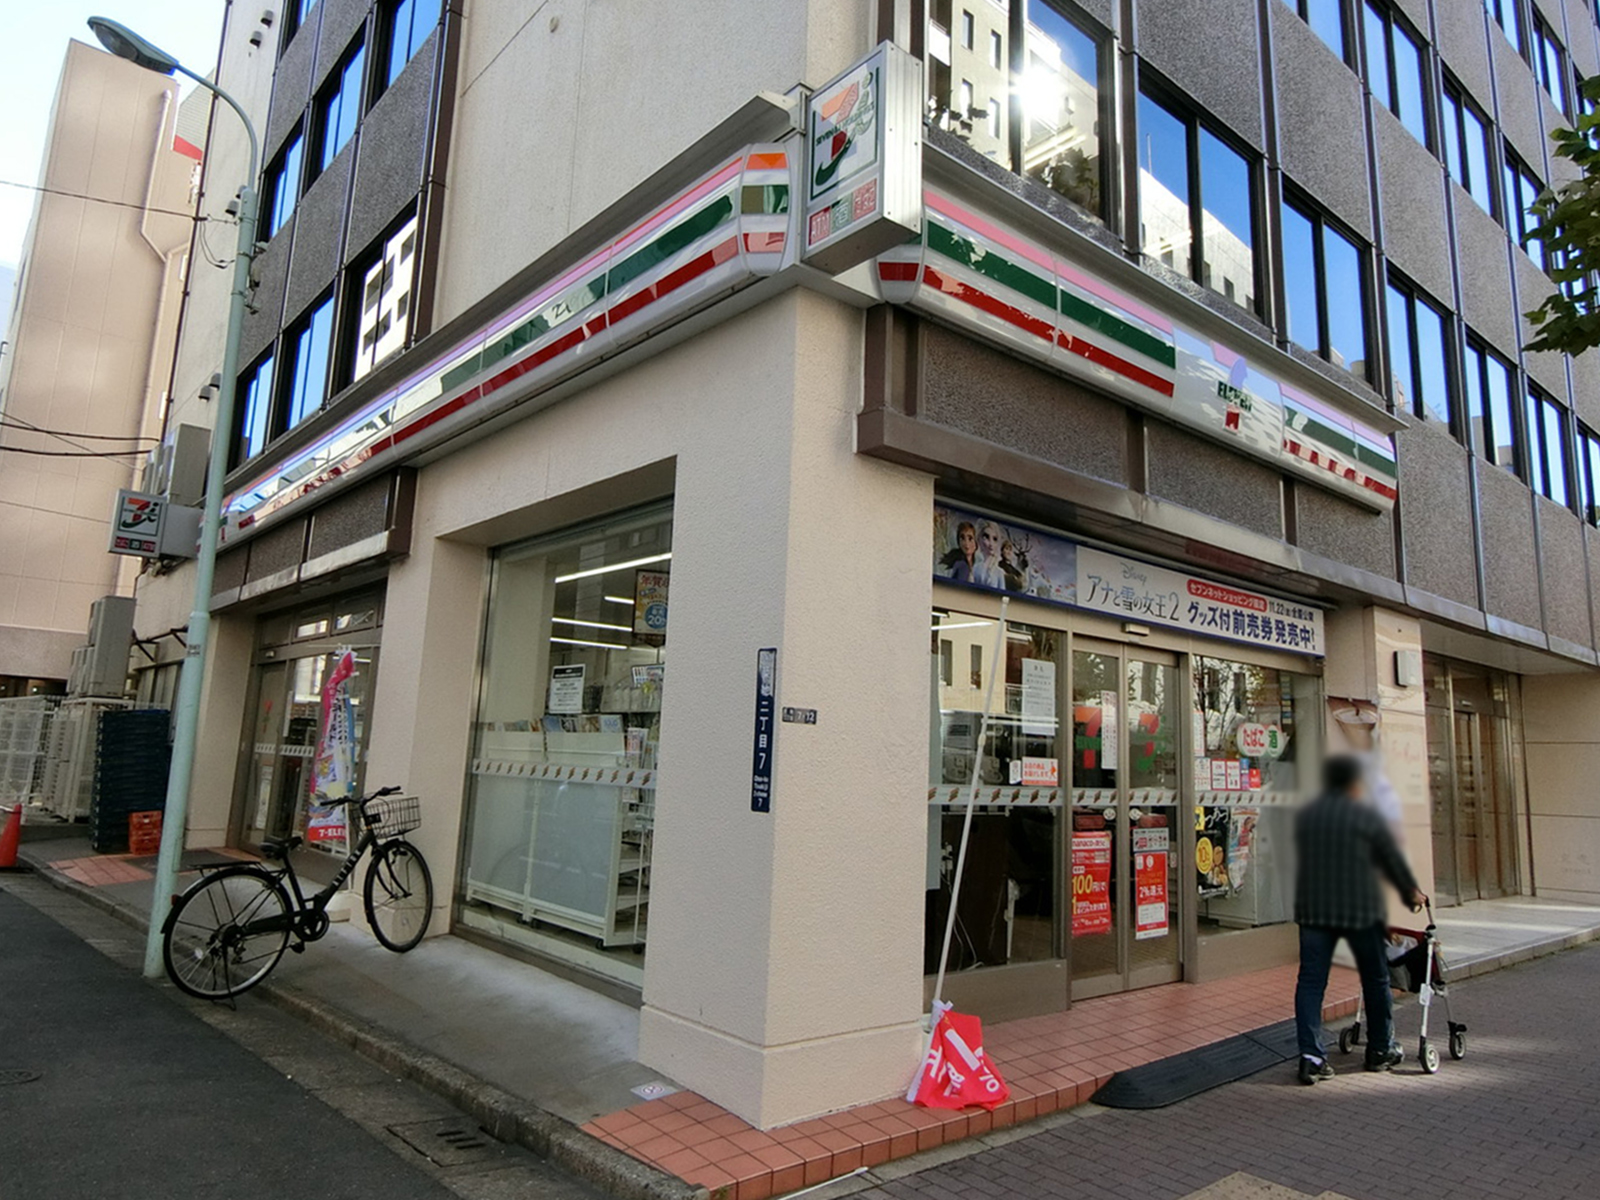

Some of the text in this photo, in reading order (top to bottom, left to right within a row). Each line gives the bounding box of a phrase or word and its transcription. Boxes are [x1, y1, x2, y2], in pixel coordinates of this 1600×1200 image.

[1120, 563, 1147, 585] Disney
[1087, 574, 1180, 622] アナと雪の女王2
